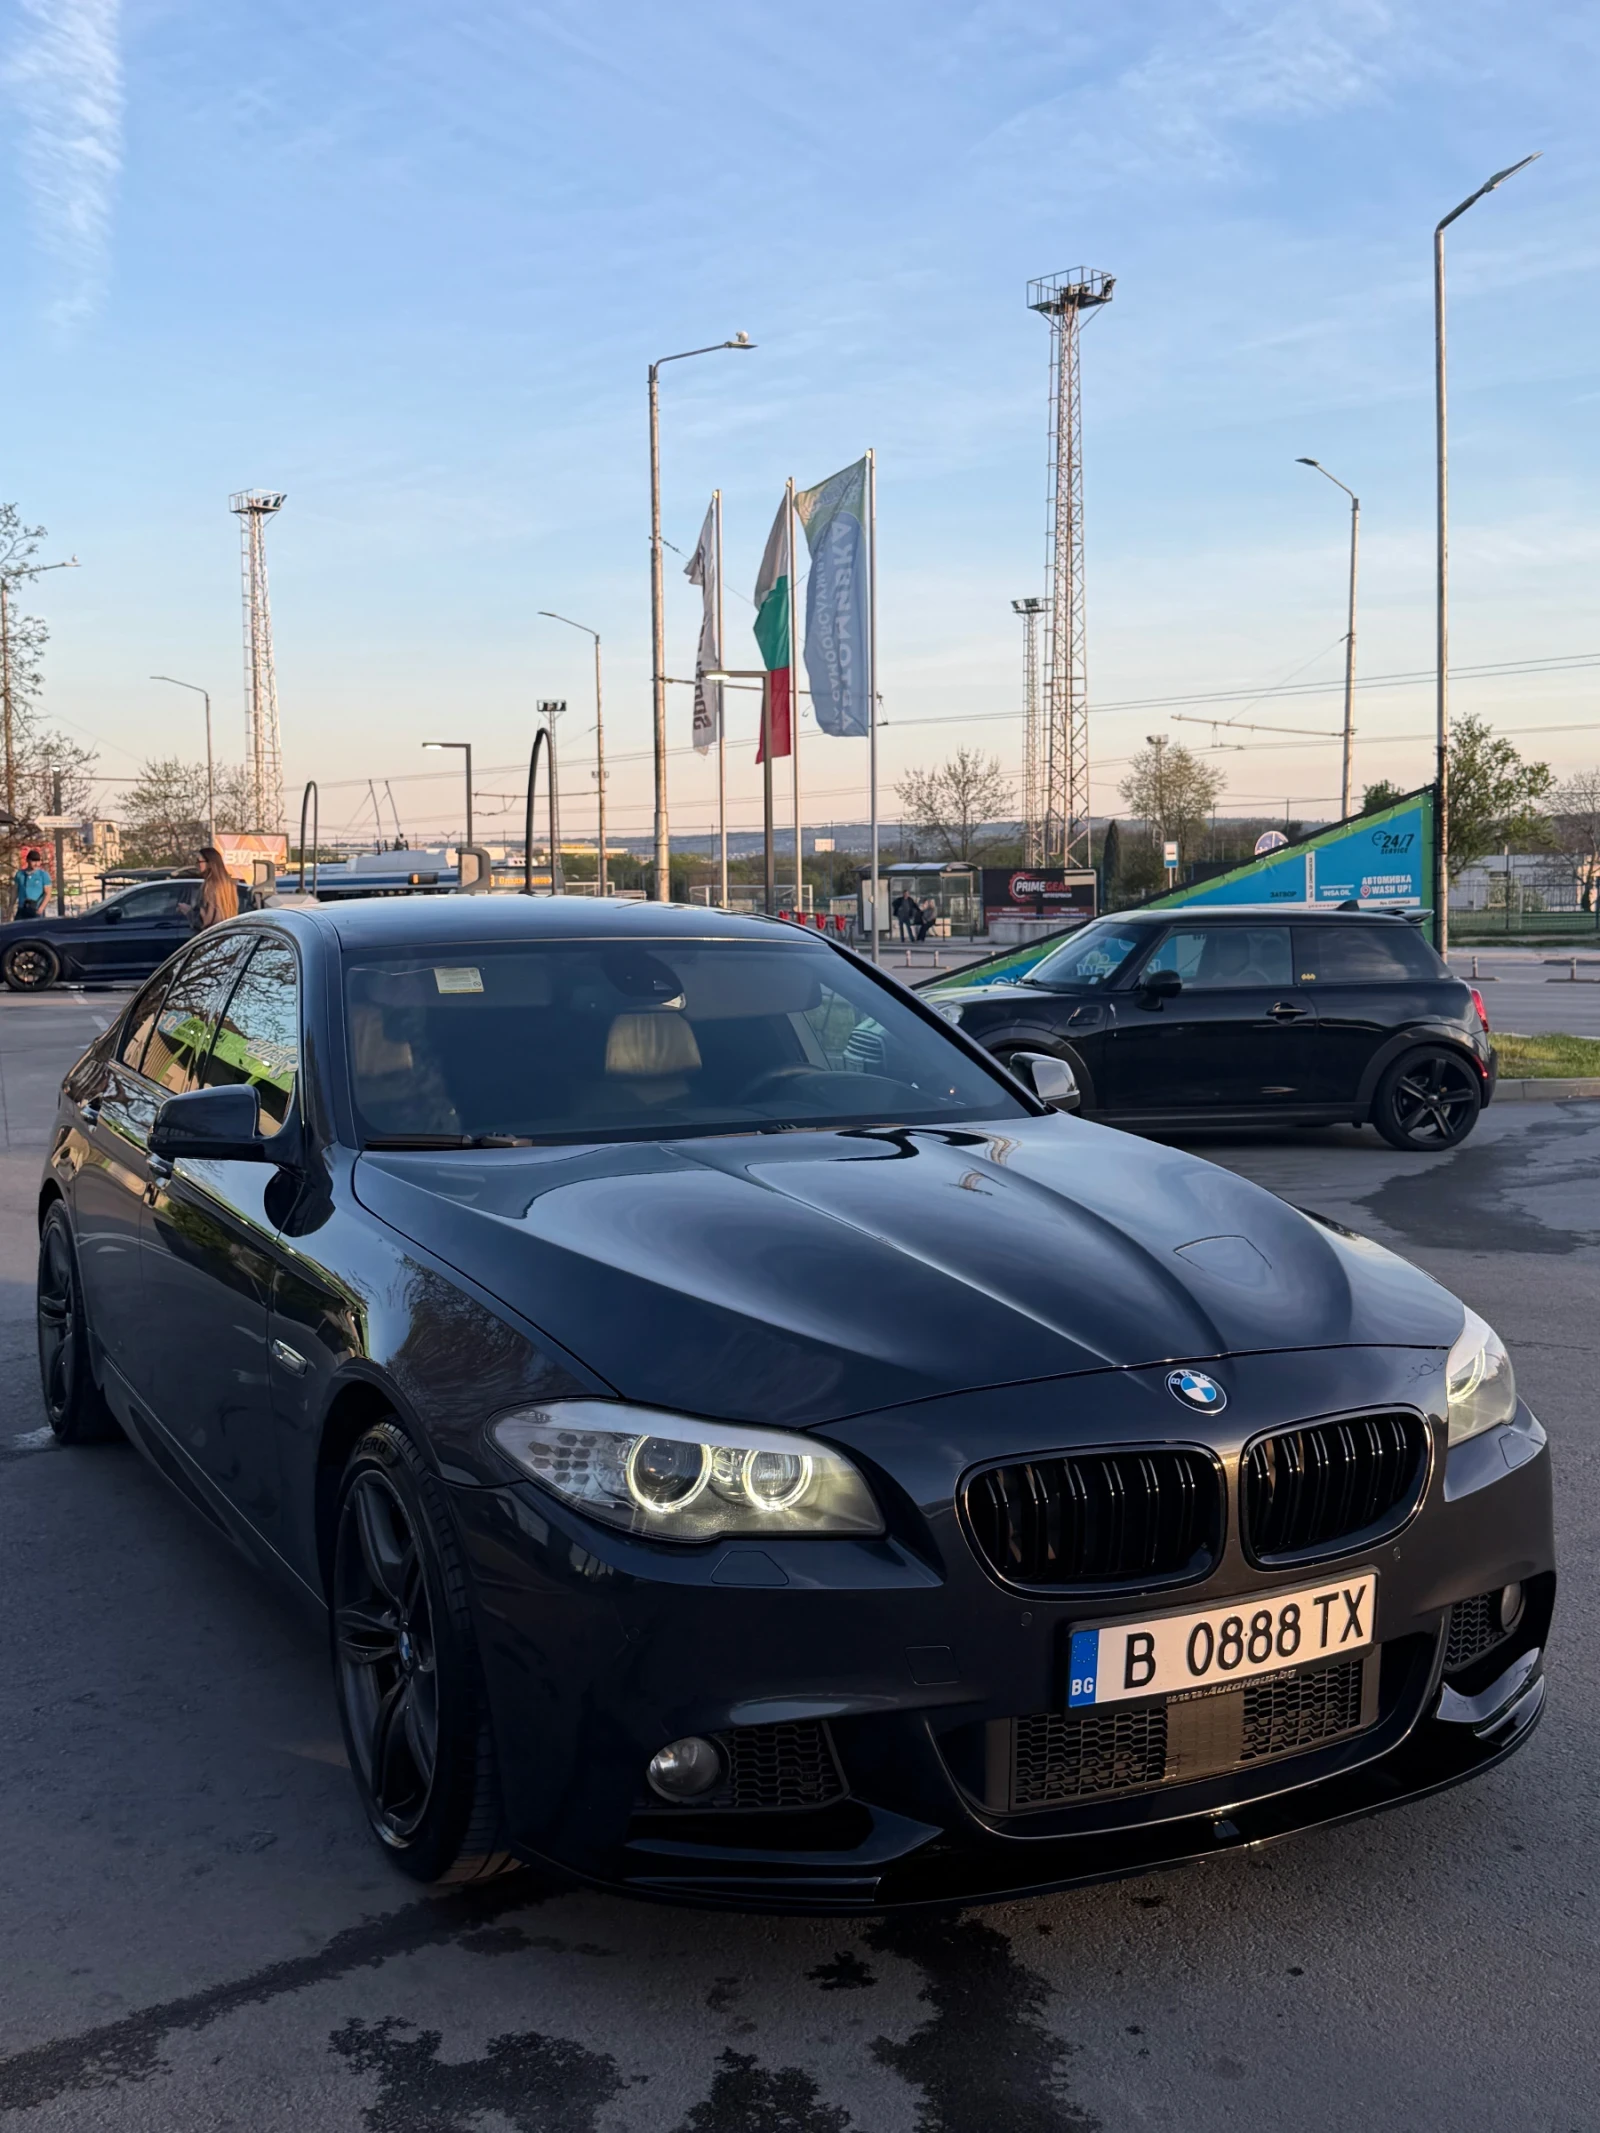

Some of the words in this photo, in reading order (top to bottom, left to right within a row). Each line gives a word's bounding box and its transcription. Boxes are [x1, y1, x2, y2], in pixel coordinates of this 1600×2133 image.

[1382, 833, 1415, 848] 24/7
[1362, 874, 1412, 886] АВТОМИВКА
[1372, 885, 1396, 895] WASH
[1397, 884, 1411, 894] UP!
[1124, 1632, 1156, 1689] B
[1188, 1603, 1301, 1677] 0888
[1314, 1584, 1367, 1648] TX
[1071, 1678, 1094, 1696] BG
[1166, 1669, 1297, 1704] www.AutoHaus.bg
